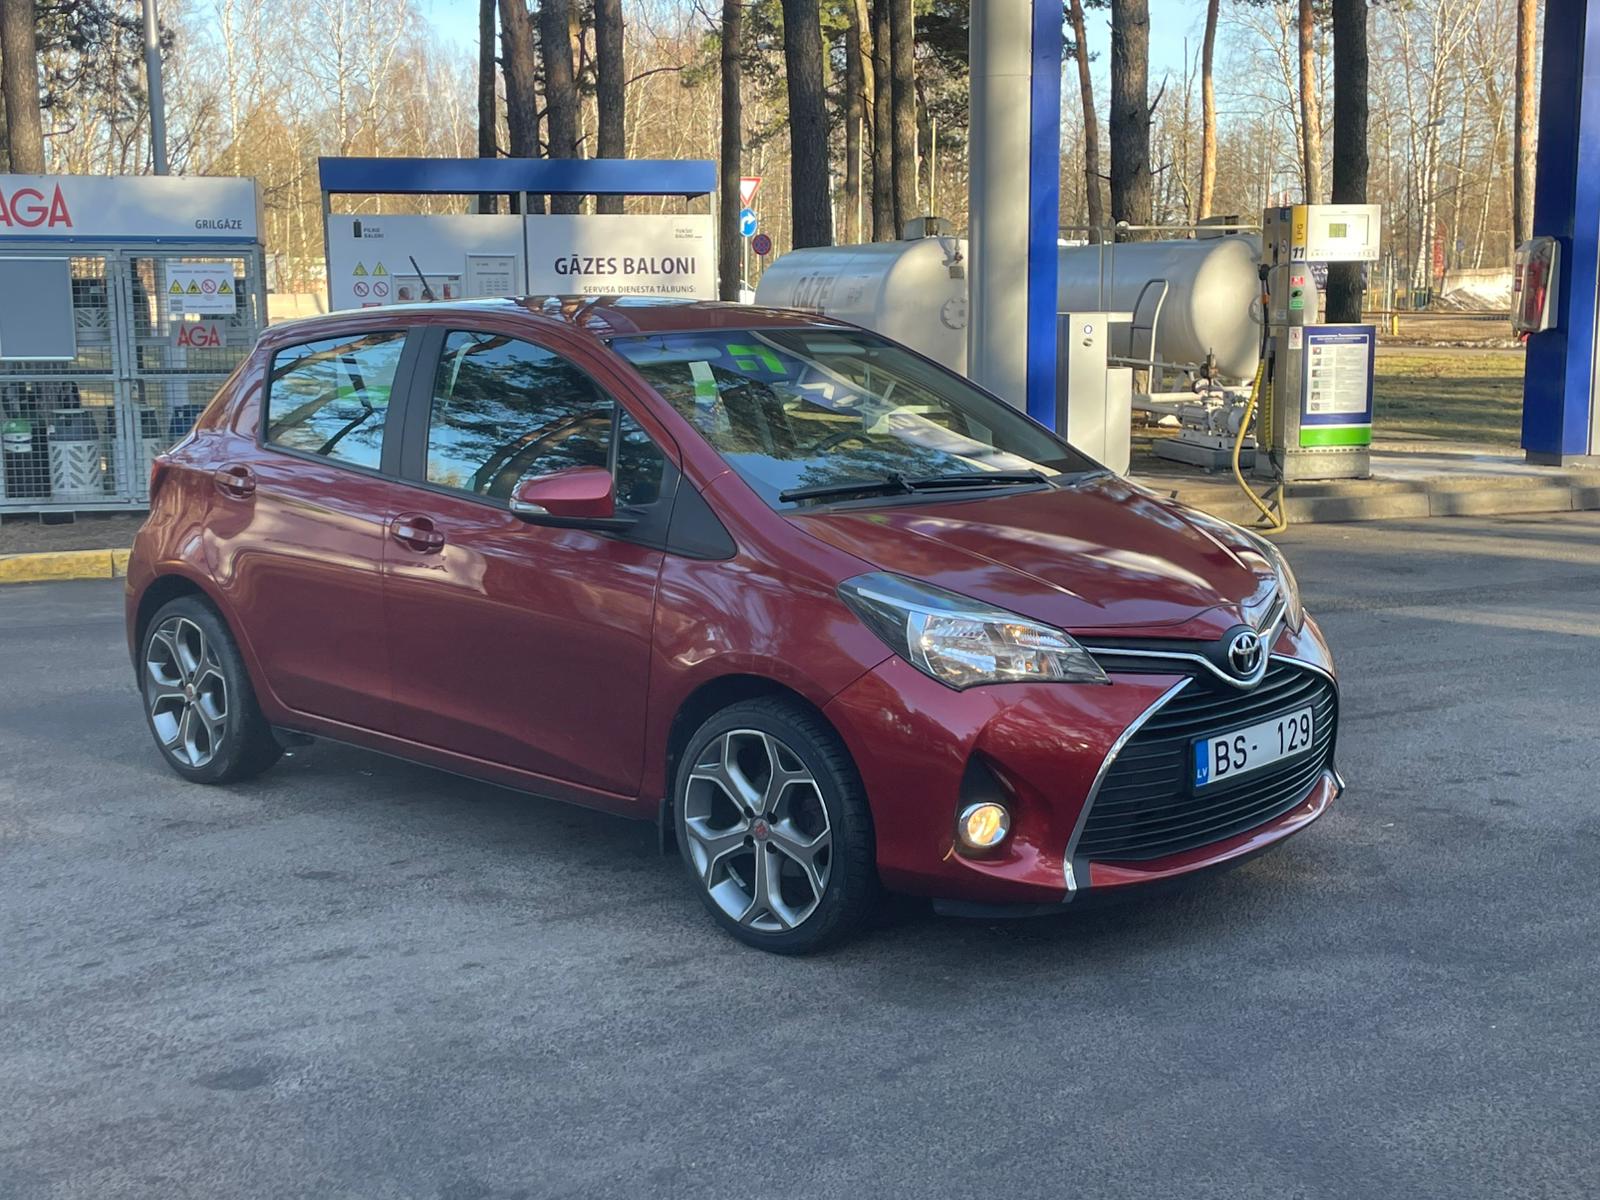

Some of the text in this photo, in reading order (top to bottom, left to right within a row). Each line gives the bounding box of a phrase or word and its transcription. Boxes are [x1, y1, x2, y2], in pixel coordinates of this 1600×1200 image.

[195, 218, 243, 230] GRILGĀZE
[1296, 223, 1304, 240] LPG
[1292, 247, 1305, 259] 11
[554, 254, 695, 275] GĀZES BALONI
[583, 285, 616, 294] SERVISA
[618, 285, 655, 293] DIENESTA
[177, 323, 221, 347] AGA
[1277, 713, 1310, 755] 129
[1197, 767, 1208, 779] LV
